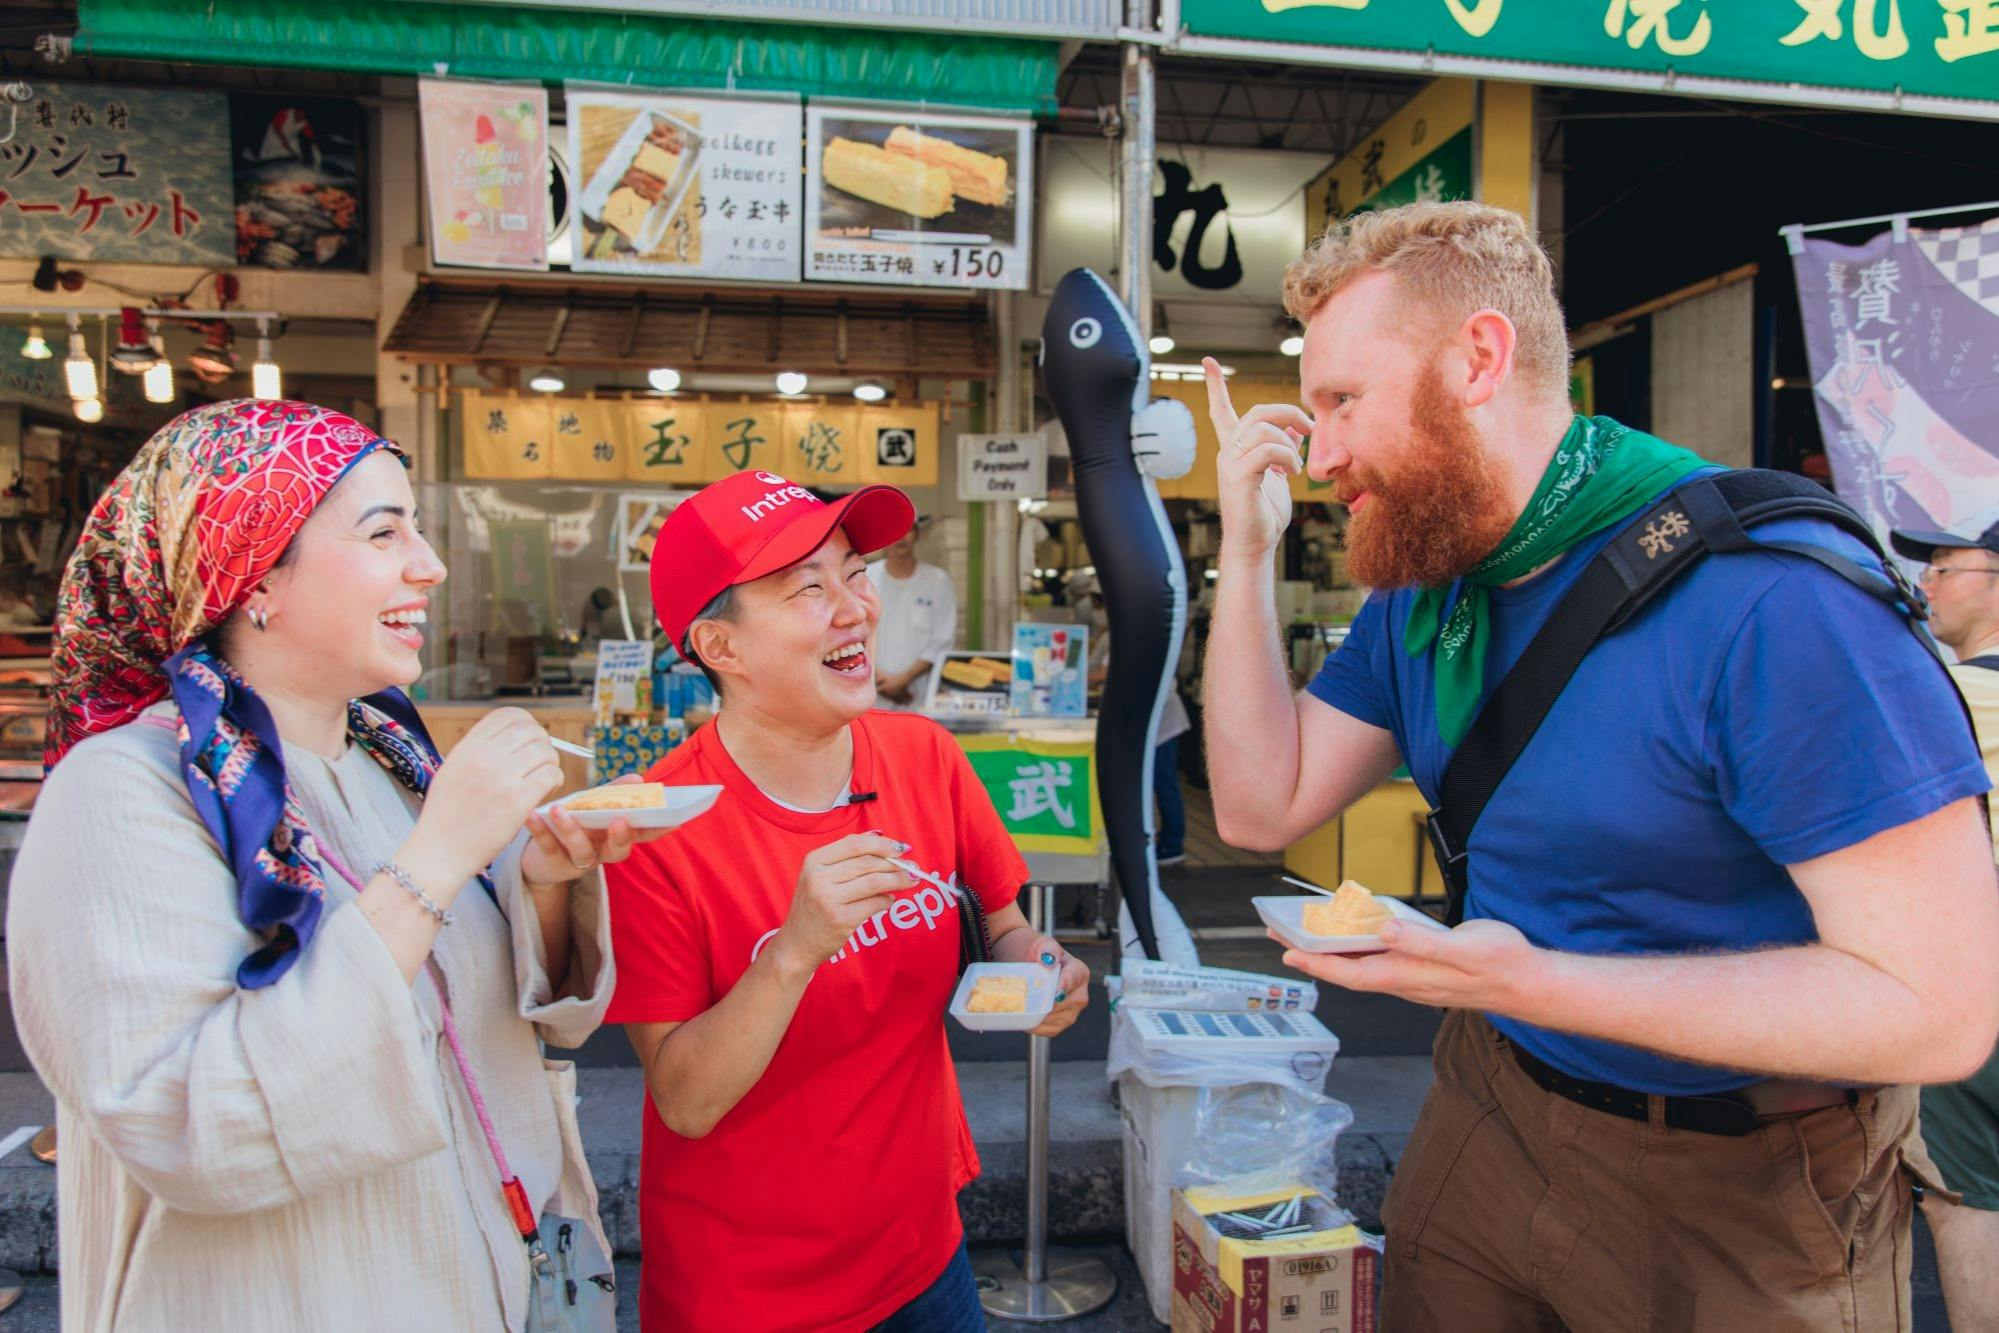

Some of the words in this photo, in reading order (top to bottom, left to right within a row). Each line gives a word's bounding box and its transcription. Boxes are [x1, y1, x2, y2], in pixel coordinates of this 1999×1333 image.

[712, 164, 787, 184] skewers
[0, 186, 201, 237] ーケット
[694, 194, 791, 224] うな玉串
[860, 254, 914, 274] 玉子焼
[932, 248, 1004, 278] ¥150
[740, 486, 822, 522] Intrep
[1007, 760, 1075, 829] 武
[1246, 1267, 1266, 1311] ヤマサ
[1248, 1318, 1261, 1331] A
